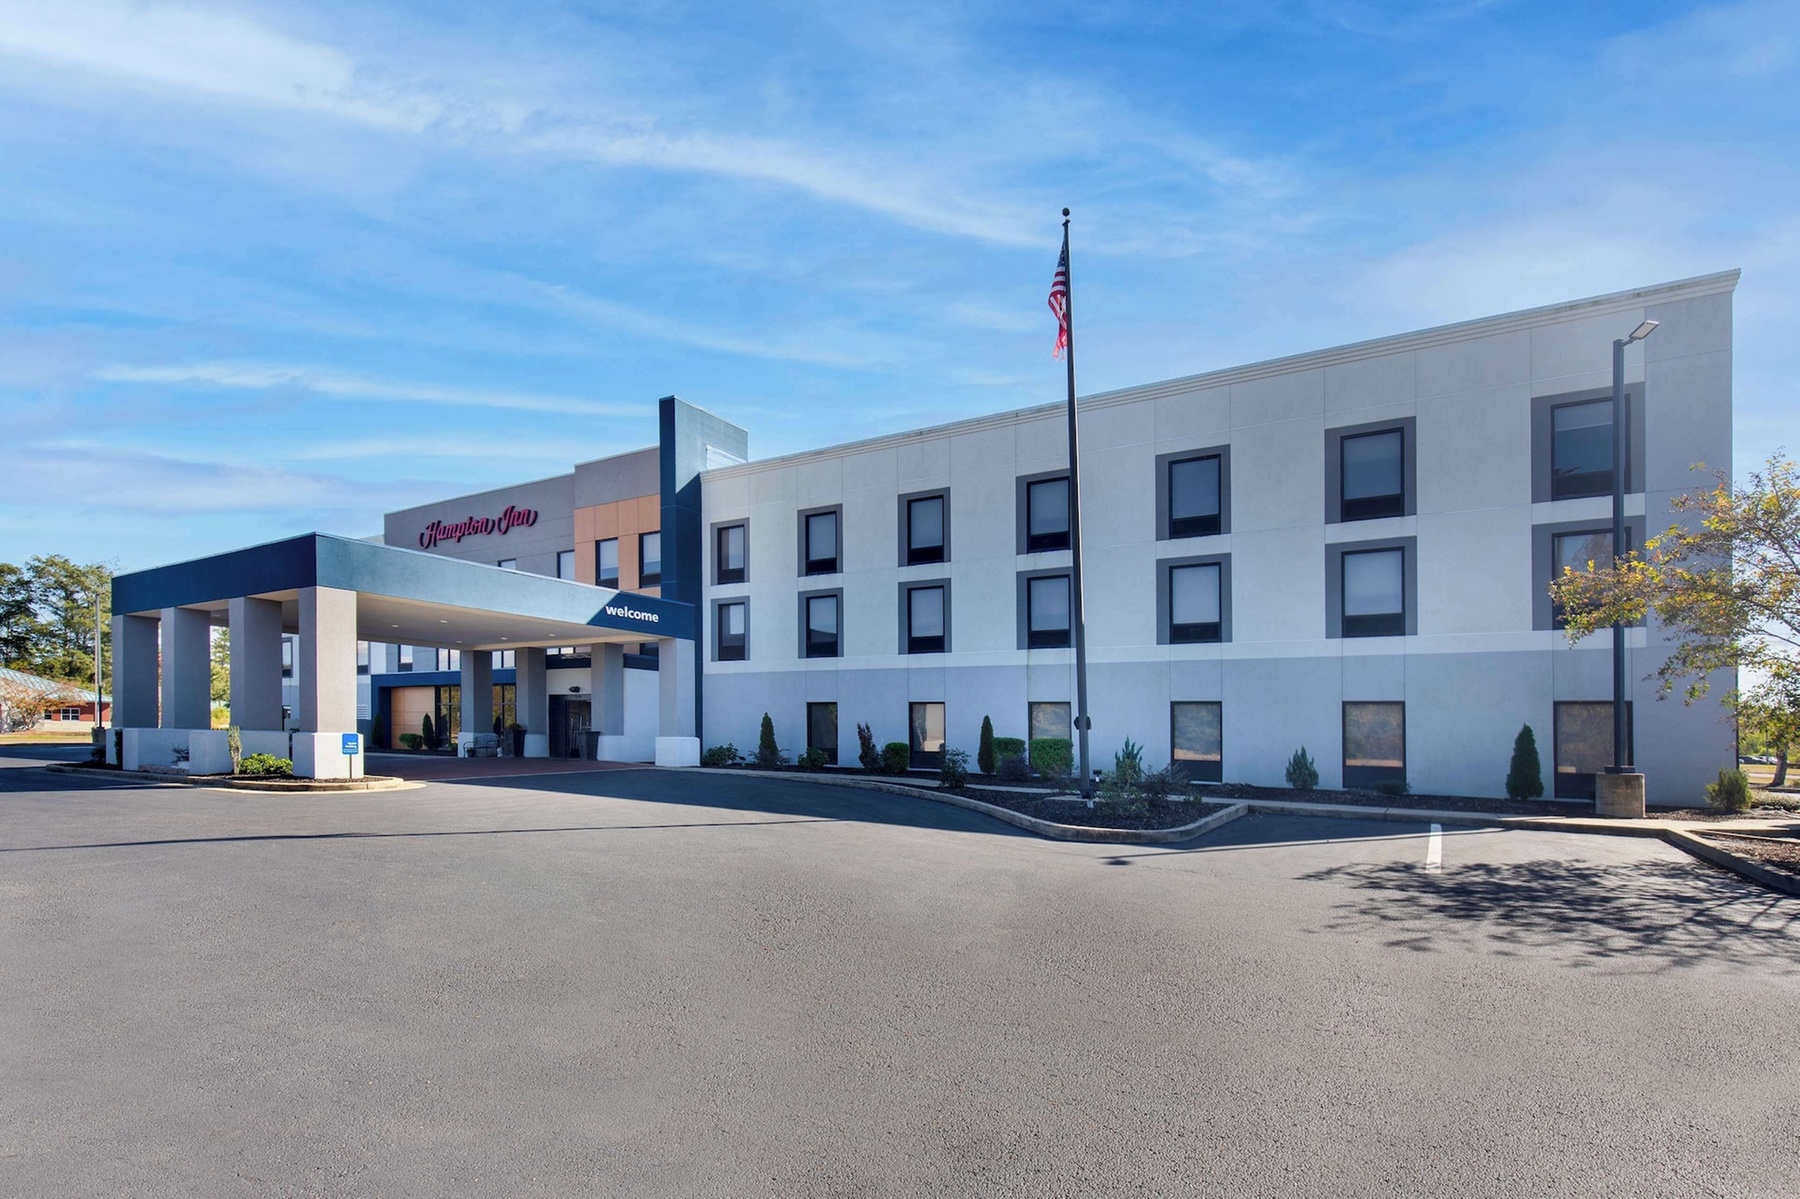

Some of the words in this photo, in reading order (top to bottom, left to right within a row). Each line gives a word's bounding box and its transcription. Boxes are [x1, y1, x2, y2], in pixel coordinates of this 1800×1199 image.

[420, 516, 495, 549] Hampton
[497, 505, 538, 535] Inn
[605, 606, 659, 622] welcome
